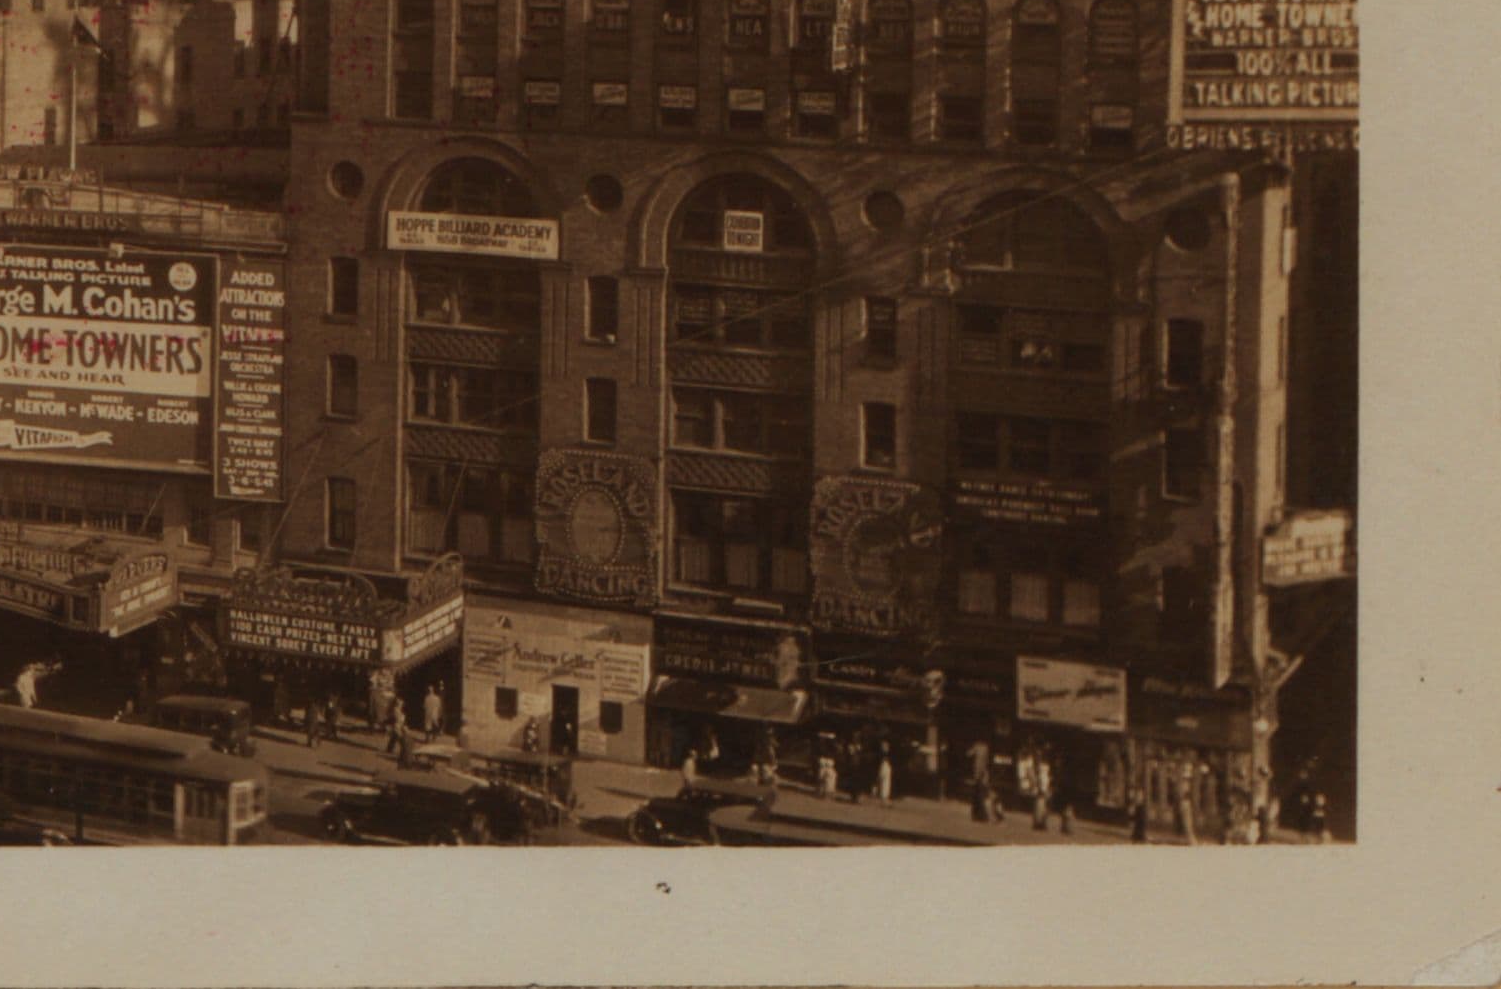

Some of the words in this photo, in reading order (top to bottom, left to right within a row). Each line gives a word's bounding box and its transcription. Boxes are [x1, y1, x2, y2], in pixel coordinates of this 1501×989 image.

[1205, 3, 1264, 28] HOME
[1211, 28, 1291, 47] WARNER
[1236, 50, 1293, 76] 100%
[1295, 50, 1333, 76] ALL
[1194, 81, 1282, 106] TALKING
[4, 210, 77, 229] WARNER
[395, 217, 436, 233] HOPPE
[437, 219, 491, 236] BILLIARD
[492, 223, 553, 241] ACADEMY
[460, 235, 508, 248] BROADWAY
[11, 268, 75, 285] TALKING
[80, 271, 152, 287] PICTURE
[230, 271, 275, 287] ADDED
[42, 284, 78, 316] M.
[82, 286, 195, 323] Cohan's
[219, 287, 285, 308] ATTRACTIONS
[249, 309, 273, 323] THE
[3, 366, 37, 379] SEE
[38, 368, 70, 382] AND
[77, 370, 125, 386] HEAR
[14, 398, 68, 416] KENYON
[146, 407, 199, 426] EDESON
[540, 459, 650, 518] ROSELAND
[543, 563, 648, 596] DANCING
[229, 609, 289, 627] HALLOWEEN
[291, 616, 336, 634] COSTUME
[342, 623, 376, 638] PARTY
[256, 623, 282, 636] CASH
[230, 632, 271, 648] VINCENT
[275, 637, 307, 652] SOREY
[312, 642, 345, 657] EVERY
[350, 648, 370, 660] AFT
